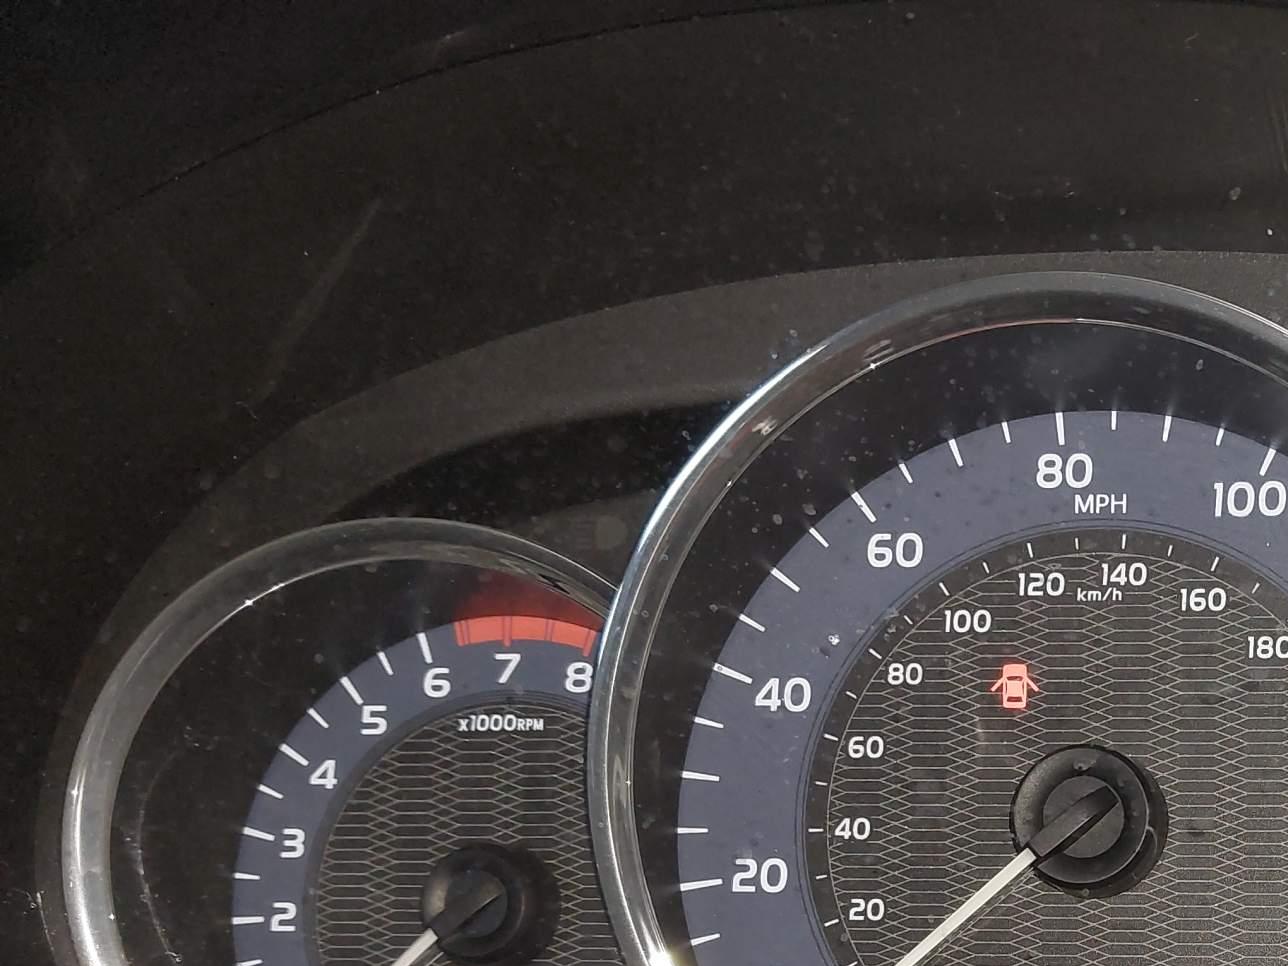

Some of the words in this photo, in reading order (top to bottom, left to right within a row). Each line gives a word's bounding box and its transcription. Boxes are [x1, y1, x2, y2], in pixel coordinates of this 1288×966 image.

[1036, 453, 1093, 489] 80
[1074, 493, 1127, 514] MPH
[1213, 480, 1287, 518] 100
[867, 532, 923, 568] 60
[1018, 572, 1065, 597] 120
[1101, 562, 1147, 586] 140
[1076, 587, 1122, 602] km/h
[1180, 587, 1227, 612] 160
[944, 609, 992, 633] 100
[423, 667, 451, 698] 6
[494, 653, 521, 684] 7
[565, 661, 594, 693] 8
[887, 662, 923, 685] 80
[754, 677, 811, 712] 40
[361, 705, 387, 735] 5
[848, 735, 884, 759] 60
[309, 759, 338, 789] 4
[280, 828, 305, 858] 3
[834, 817, 871, 840] 40
[732, 857, 788, 893] 20
[270, 902, 297, 932] 2
[849, 898, 885, 921] 20
